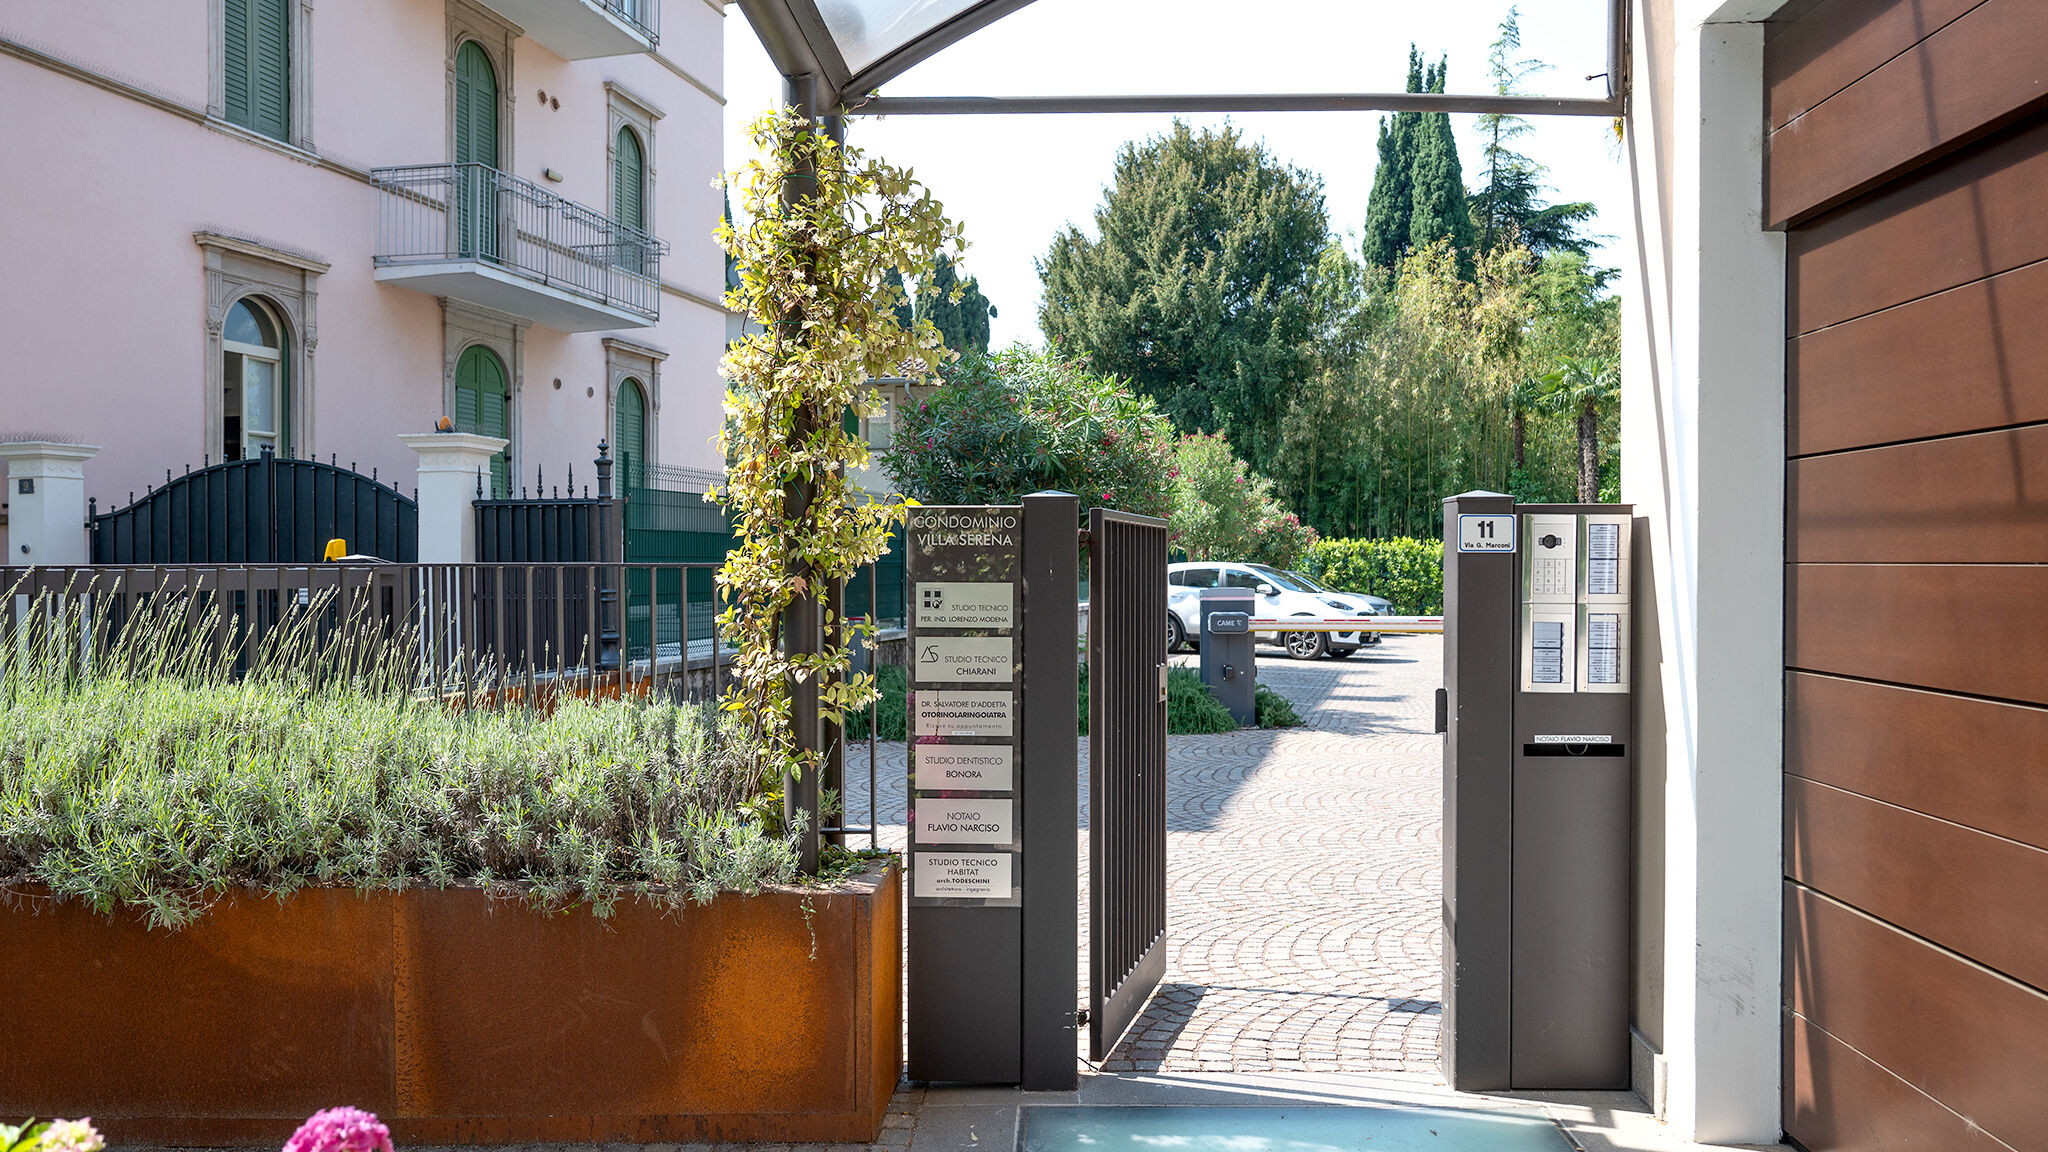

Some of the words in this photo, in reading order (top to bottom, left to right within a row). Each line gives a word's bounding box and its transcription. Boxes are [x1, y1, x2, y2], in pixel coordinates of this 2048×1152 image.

[914, 515, 1017, 529] CONDOMINIO
[1477, 520, 1494, 539] 11
[917, 534, 955, 546] VILLA
[958, 534, 1014, 546] SERENA
[951, 604, 977, 612] STUDIO
[978, 604, 1008, 612] TECNICO
[944, 656, 972, 664] STUDIO
[974, 656, 1008, 664] TECNICO
[956, 668, 997, 676] CHIARANI
[925, 756, 955, 765] STUDIO
[956, 756, 1004, 765] DENTISTICO
[946, 770, 982, 778] BONORA
[946, 812, 980, 820] NOTAIO
[928, 824, 958, 832] FLAVIO
[960, 824, 1000, 832] NARCISO
[928, 858, 960, 866] STUDIO
[961, 858, 998, 866] TECNICO
